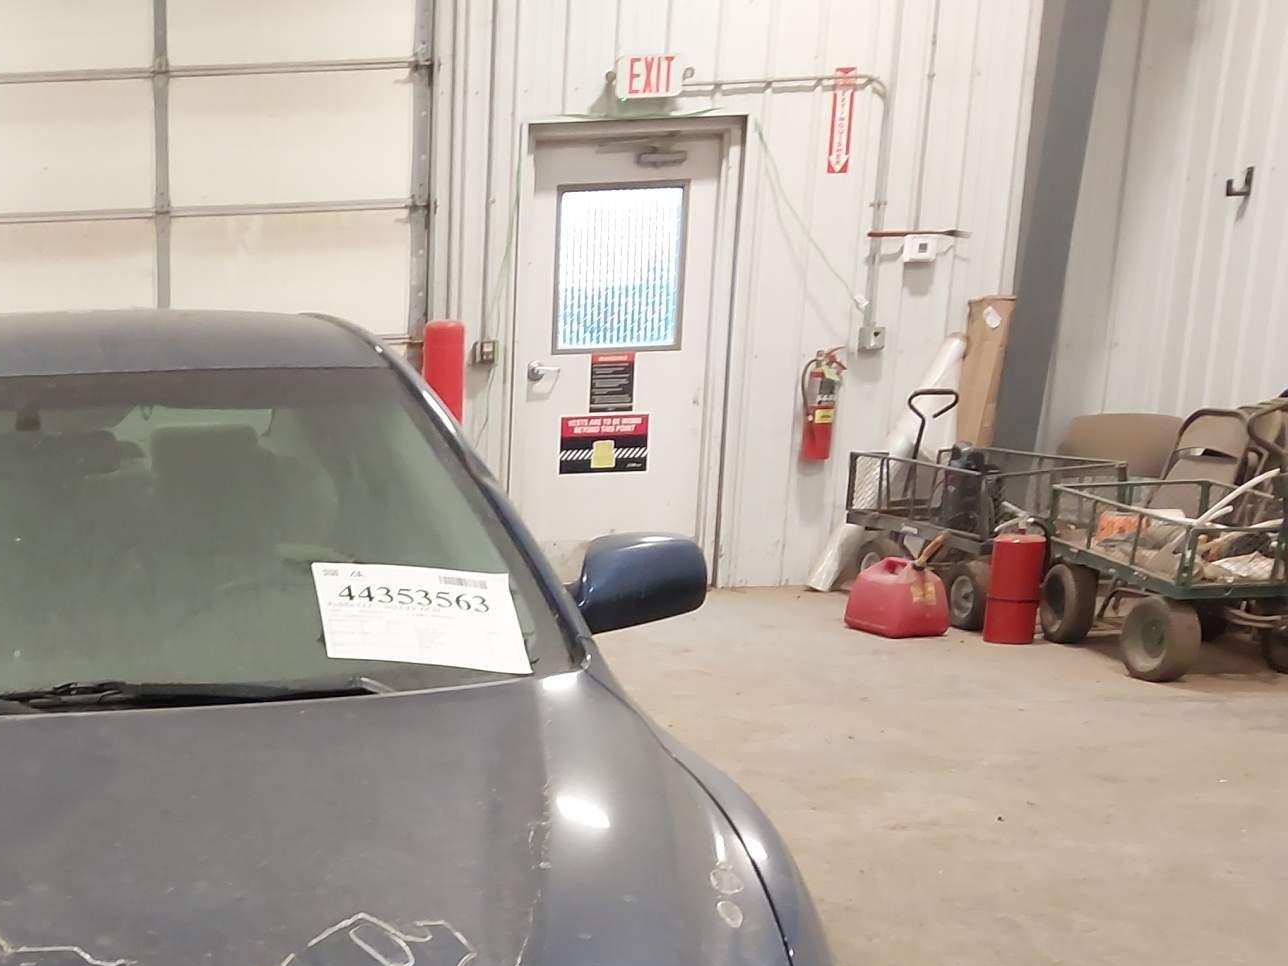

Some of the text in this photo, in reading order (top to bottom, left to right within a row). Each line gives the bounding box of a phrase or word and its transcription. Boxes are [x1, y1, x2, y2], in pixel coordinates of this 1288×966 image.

[628, 56, 675, 94] EXIT
[589, 418, 601, 426] ARE
[615, 424, 636, 432] POINT
[338, 584, 490, 613] 44353563
